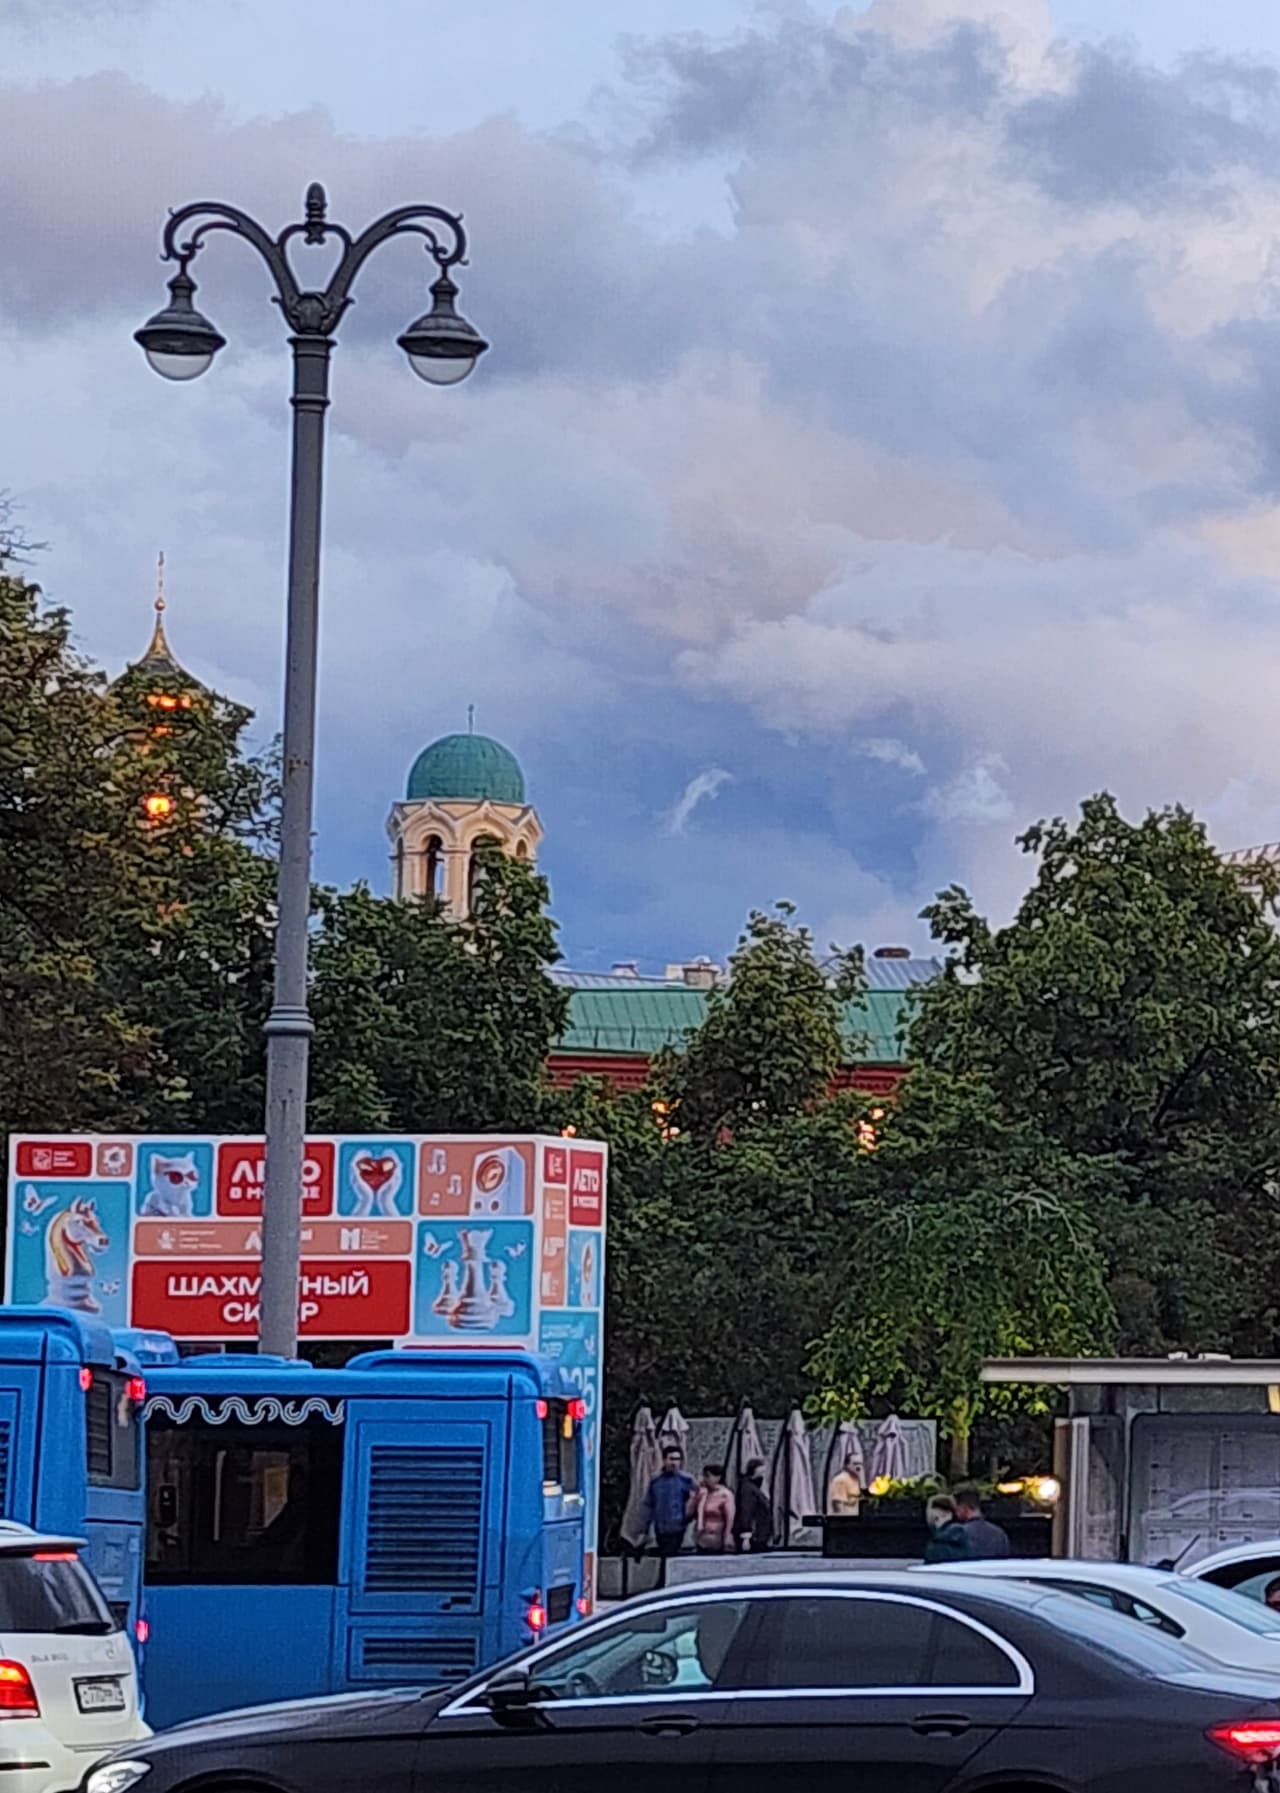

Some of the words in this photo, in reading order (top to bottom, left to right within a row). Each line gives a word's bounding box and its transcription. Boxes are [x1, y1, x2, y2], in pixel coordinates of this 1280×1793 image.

[232, 1160, 321, 1183] ЛО
[229, 1186, 242, 1199] В
[167, 1270, 369, 1296] ШАХМНЫЙ
[223, 1302, 319, 1322] СКР
